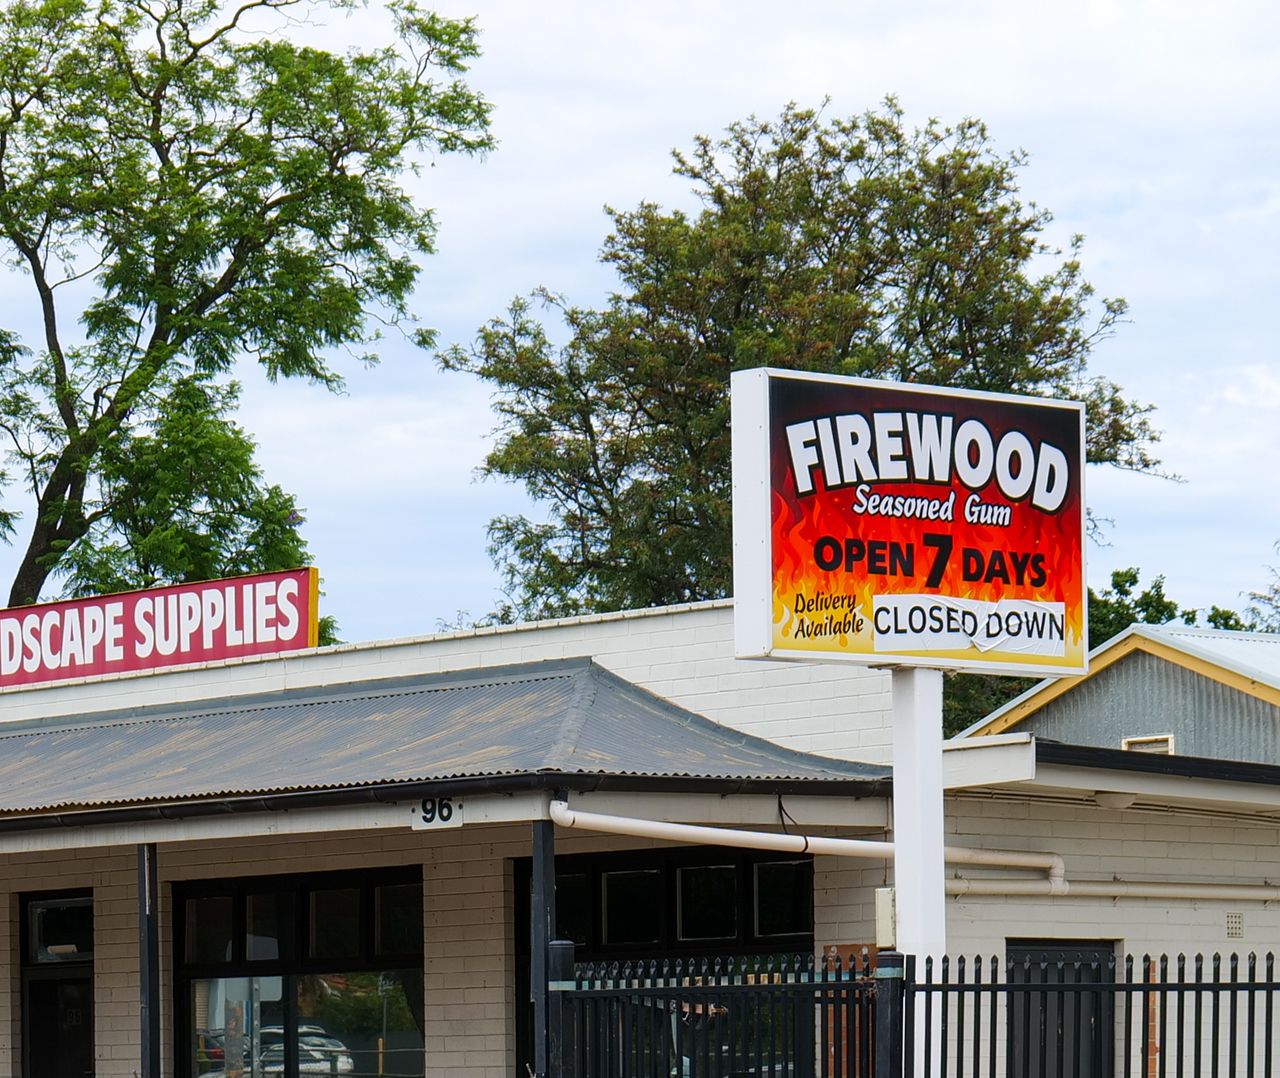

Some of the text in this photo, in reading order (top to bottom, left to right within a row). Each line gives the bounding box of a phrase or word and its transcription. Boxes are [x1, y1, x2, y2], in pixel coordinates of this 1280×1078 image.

[785, 411, 1069, 512] FIREWOOD
[853, 484, 1012, 527] Seasoned Gum
[814, 533, 1047, 589] OPEN 7 DAYS
[134, 577, 300, 659] SUPPLIES
[794, 591, 857, 614] Delivery
[794, 612, 864, 639] Available
[874, 605, 1065, 641] CLOSED DOWN
[421, 797, 453, 824] 96
